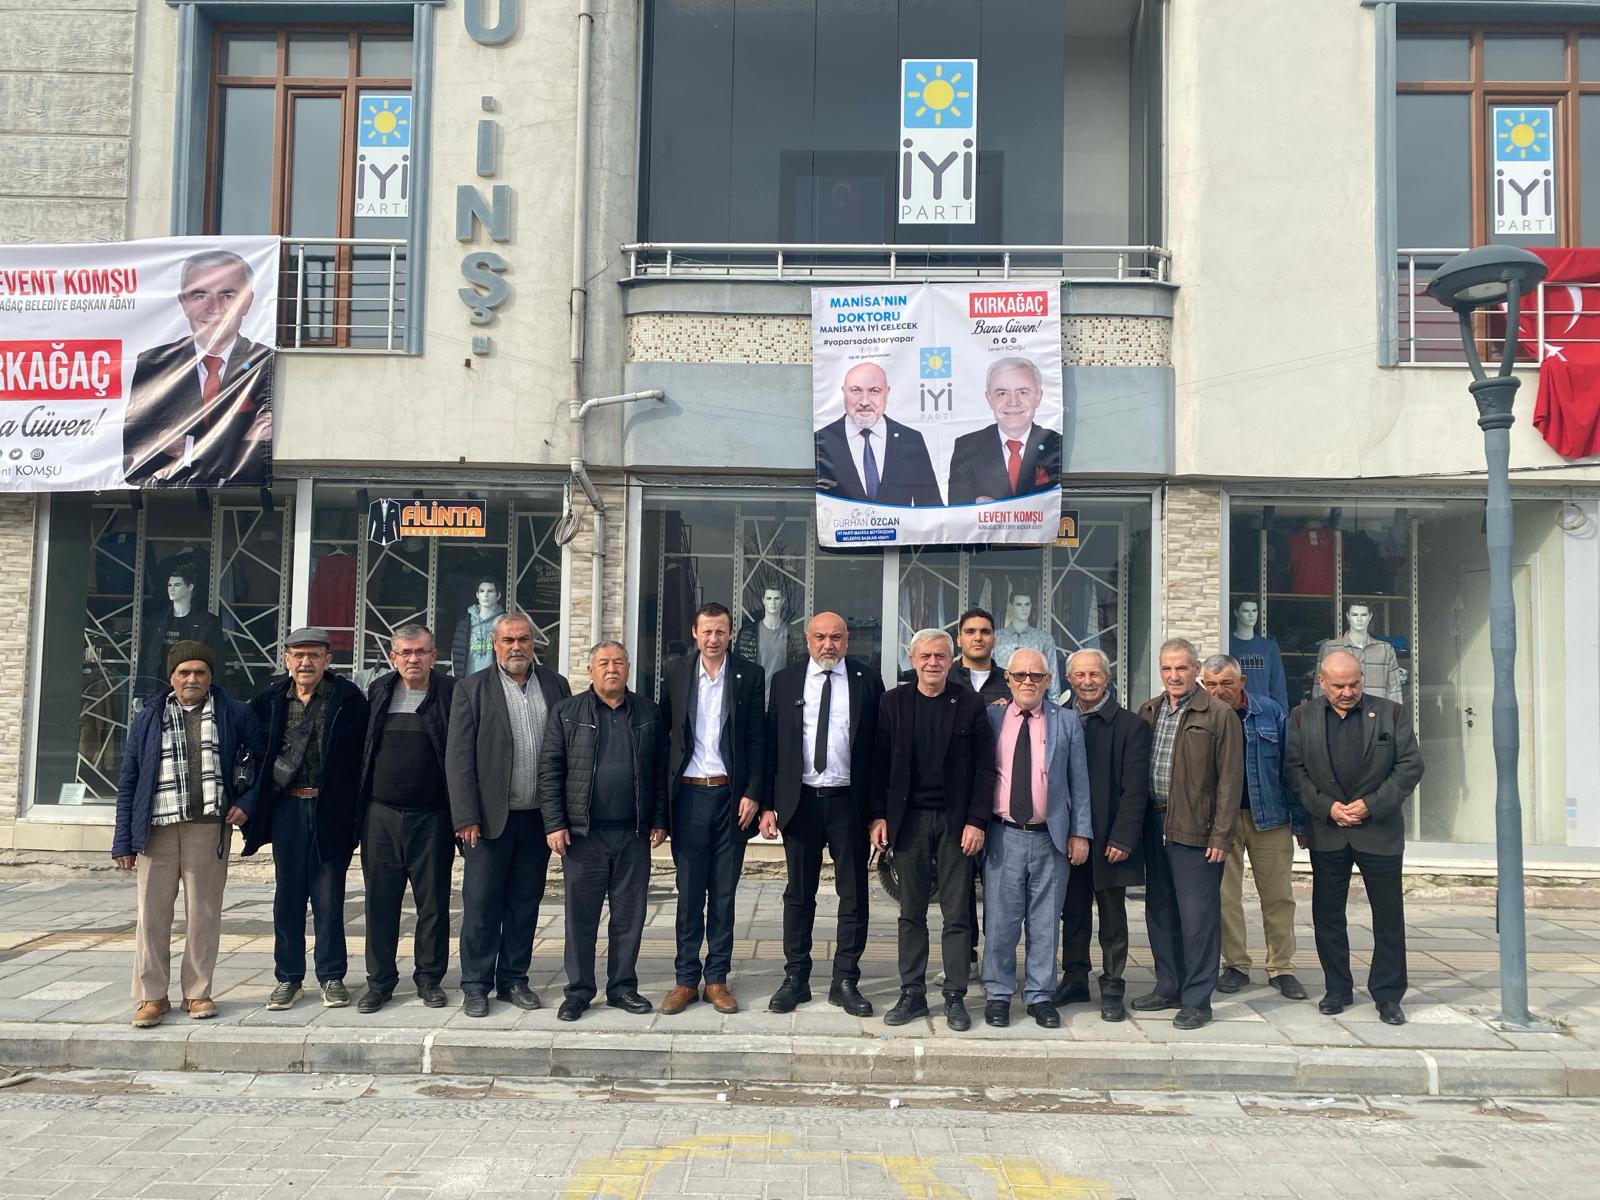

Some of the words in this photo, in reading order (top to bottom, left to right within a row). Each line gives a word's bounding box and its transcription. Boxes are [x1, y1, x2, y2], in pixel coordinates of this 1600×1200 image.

[902, 138, 973, 200] İYİ
[357, 154, 410, 200] İYİ
[1496, 168, 1552, 216] İYİ
[356, 201, 408, 215] PARTİ
[902, 203, 973, 220] PARTİ
[1497, 217, 1553, 232] PARTİ
[0, 270, 57, 296] VENT
[64, 268, 137, 298] KOMŞU
[25, 298, 69, 311] BELEDİYE
[70, 299, 107, 312] BAŞKAN
[109, 299, 136, 310] ADAYI
[974, 293, 1043, 315] KIRKAĞAÇ
[837, 312, 900, 323] DOKTORU
[867, 323, 879, 332] İYİ
[881, 322, 918, 331] GELECEK
[971, 319, 1003, 335] Bana
[1005, 318, 1042, 333] Güven!
[823, 336, 915, 346] #yaparsadoktoryapar
[920, 382, 952, 412] İYİ
[920, 411, 953, 421] PARTİ
[15, 464, 62, 479] KOMŞU
[402, 501, 482, 526] FİLİNTA
[870, 516, 900, 526] ÖZCAN
[979, 511, 1012, 523] LEVENT
[1014, 511, 1044, 524] KOMŞU
[405, 528, 438, 536] ERKEK
